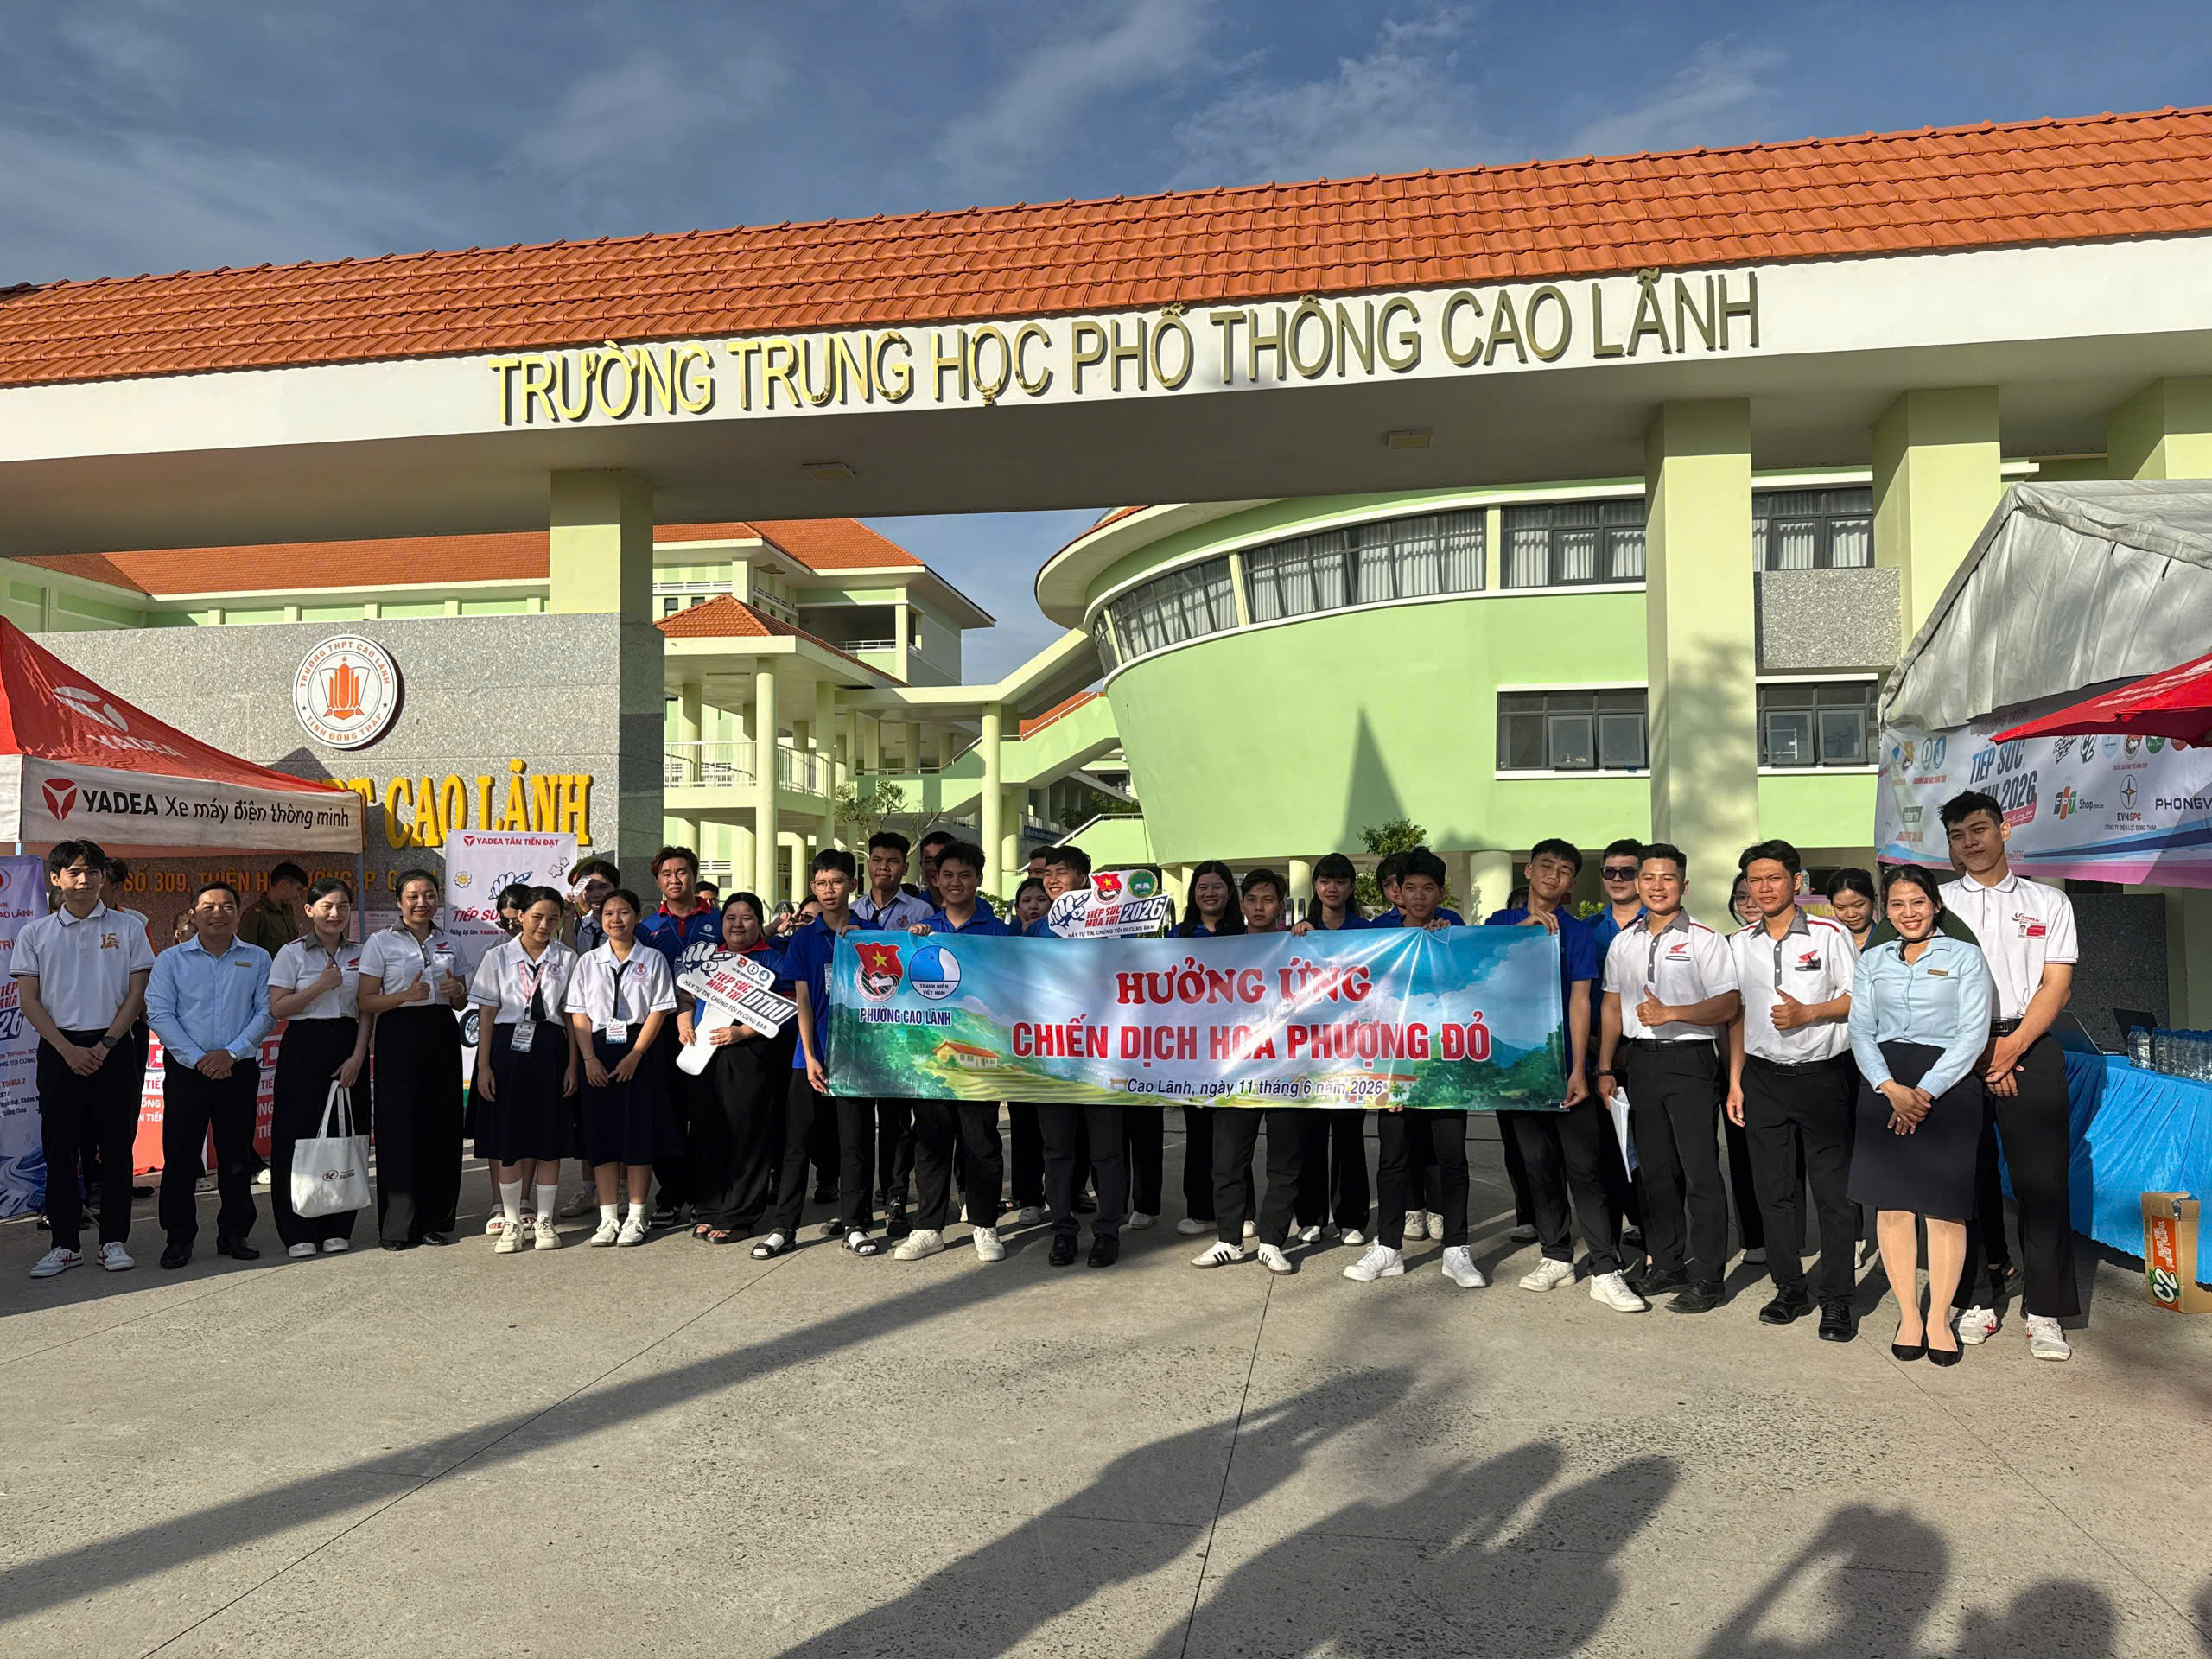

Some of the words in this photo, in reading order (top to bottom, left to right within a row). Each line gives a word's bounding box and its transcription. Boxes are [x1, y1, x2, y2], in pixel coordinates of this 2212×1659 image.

[488, 340, 716, 426] TRƯỜNG
[726, 331, 913, 410] TRUNG
[931, 322, 1054, 405] HỌC
[1071, 302, 1194, 394] PHỔ
[1211, 294, 1421, 385] THÔNG
[1440, 284, 1573, 366] CAO
[1592, 267, 1760, 359] LÃNH
[328, 641, 353, 652] THPT
[357, 643, 375, 658] CAO
[86, 734, 188, 759] YADEA
[2000, 771, 2037, 811] 2026
[82, 790, 158, 816] YADEA
[165, 796, 188, 817] Xe
[194, 798, 228, 824] máy
[234, 800, 266, 825] điện
[271, 804, 312, 829] thông
[317, 807, 349, 827] minh
[385, 774, 467, 849] CAO
[2155, 797, 2212, 810] PHONGV
[2117, 812, 2141, 821] EVNSPC
[505, 836, 522, 846] TÂN
[543, 839, 559, 848] ĐẠT
[453, 906, 478, 922] TIẾP
[1105, 916, 1119, 925] THI
[1120, 897, 1166, 923] 2026
[1116, 956, 1267, 1005] HƯỞNG
[1278, 957, 1372, 1003] ỨNG
[726, 988, 744, 1003] THI
[860, 1005, 900, 1023] PHƯỜNG
[903, 1009, 923, 1024] CAO
[925, 1008, 951, 1026] LÃNH
[1013, 1014, 1109, 1058] CHIẾN
[1120, 1025, 1198, 1068] DỊCH
[1210, 1024, 1276, 1061] HOA
[1287, 1020, 1430, 1068] PHƯỢNG
[1440, 1010, 1492, 1061] ĐỎ
[1127, 1078, 1154, 1094] Cao
[1158, 1079, 1195, 1096] Lãnh,
[1200, 1080, 1234, 1098] ngày
[1239, 1080, 1253, 1094] 11
[1259, 1079, 1299, 1097] tháng
[1303, 1079, 1312, 1095] 6
[1316, 1079, 1346, 1094] năm
[1351, 1080, 1382, 1095] 2026
[2152, 1267, 2179, 1303] C2
